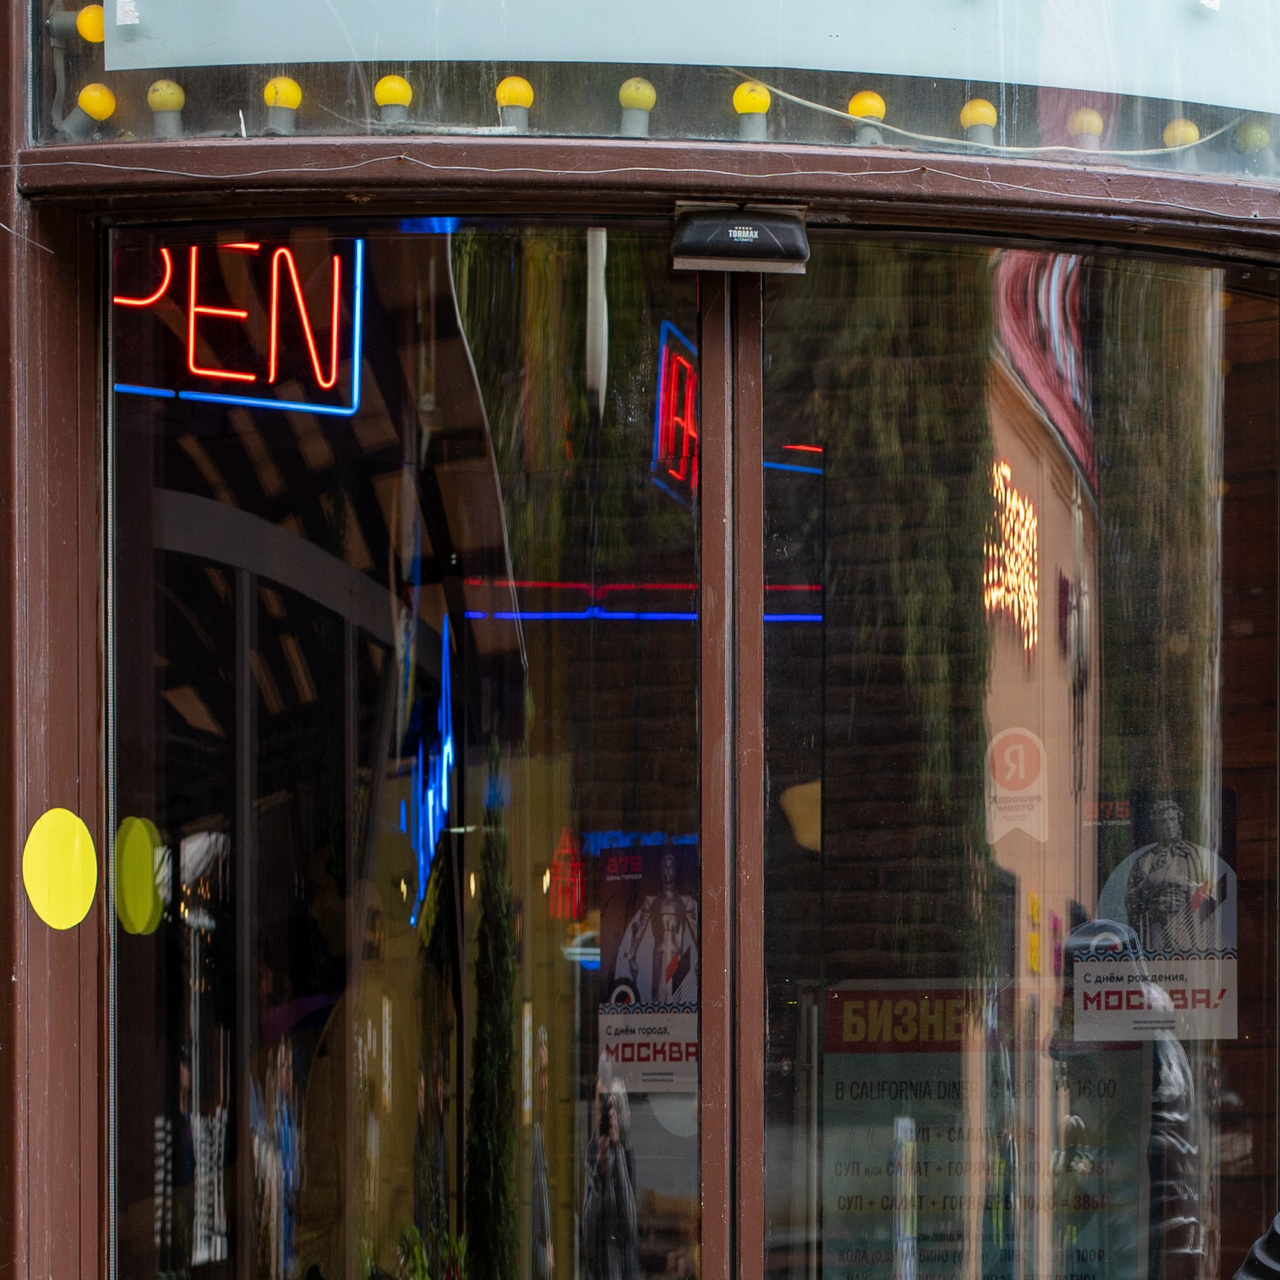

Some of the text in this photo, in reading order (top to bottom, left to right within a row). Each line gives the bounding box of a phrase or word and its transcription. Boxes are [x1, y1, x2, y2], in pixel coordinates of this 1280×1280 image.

[728, 229, 759, 239] TORMAX
[1004, 743, 1025, 781] Я
[998, 804, 1034, 812] место
[606, 856, 642, 873] 875
[1083, 972, 1188, 985] С днём рождения,
[1083, 988, 1228, 1011] МОСВА!
[606, 1025, 670, 1038] С днём города,
[835, 1081, 845, 1101] В
[850, 1081, 932, 1101] CALIFORNIA
[1076, 1079, 1117, 1099] 16:00
[835, 1162, 860, 1177] СУП
[838, 1195, 863, 1211] СУП
[839, 1249, 868, 1264] КОЛА
